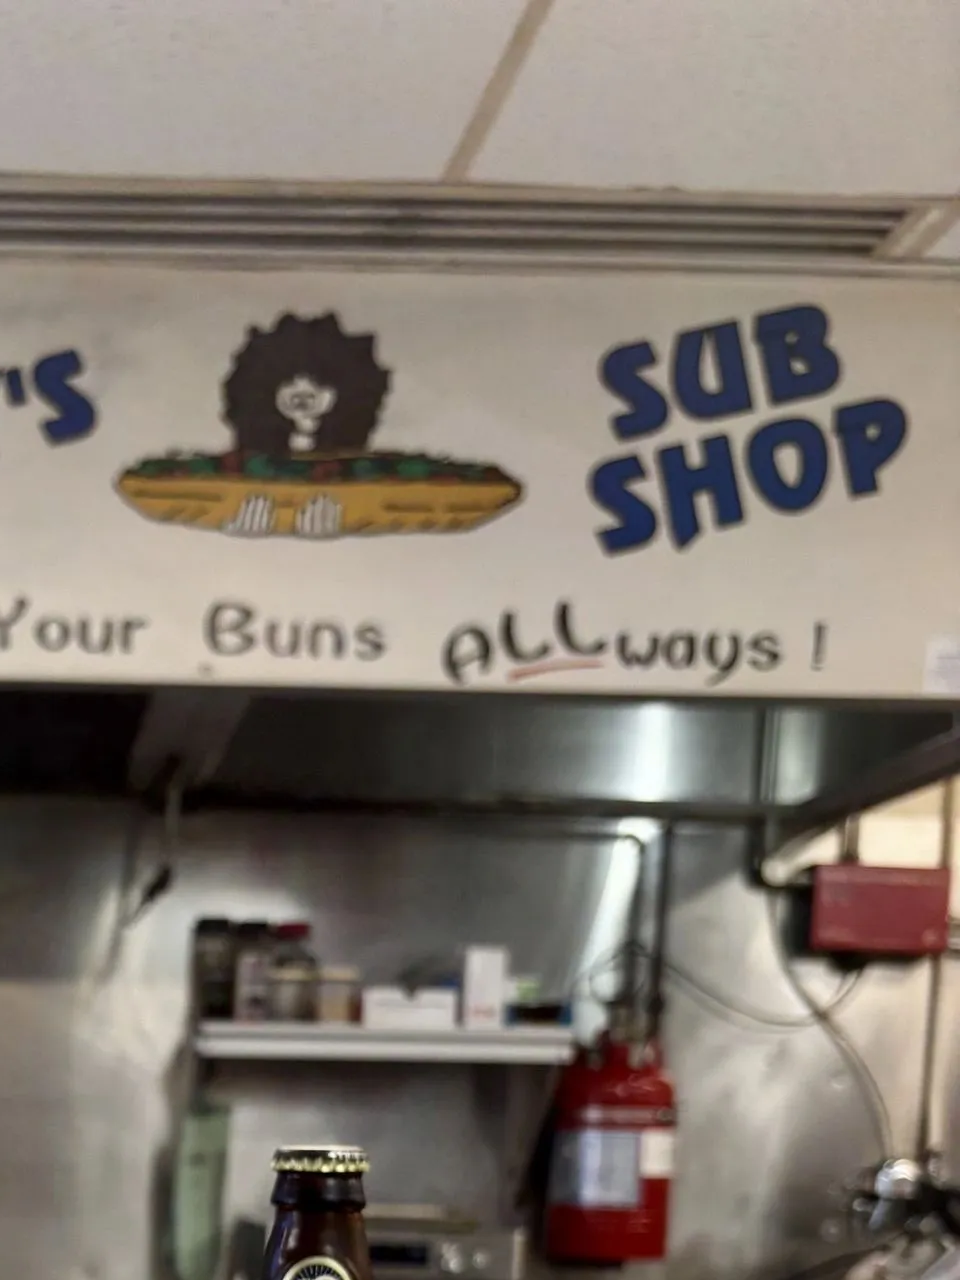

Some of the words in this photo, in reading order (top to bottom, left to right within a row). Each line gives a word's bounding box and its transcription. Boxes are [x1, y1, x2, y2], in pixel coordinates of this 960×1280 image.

[596, 302, 844, 444] SUB
[587, 398, 909, 557] SHOP
[203, 600, 388, 661] Buns
